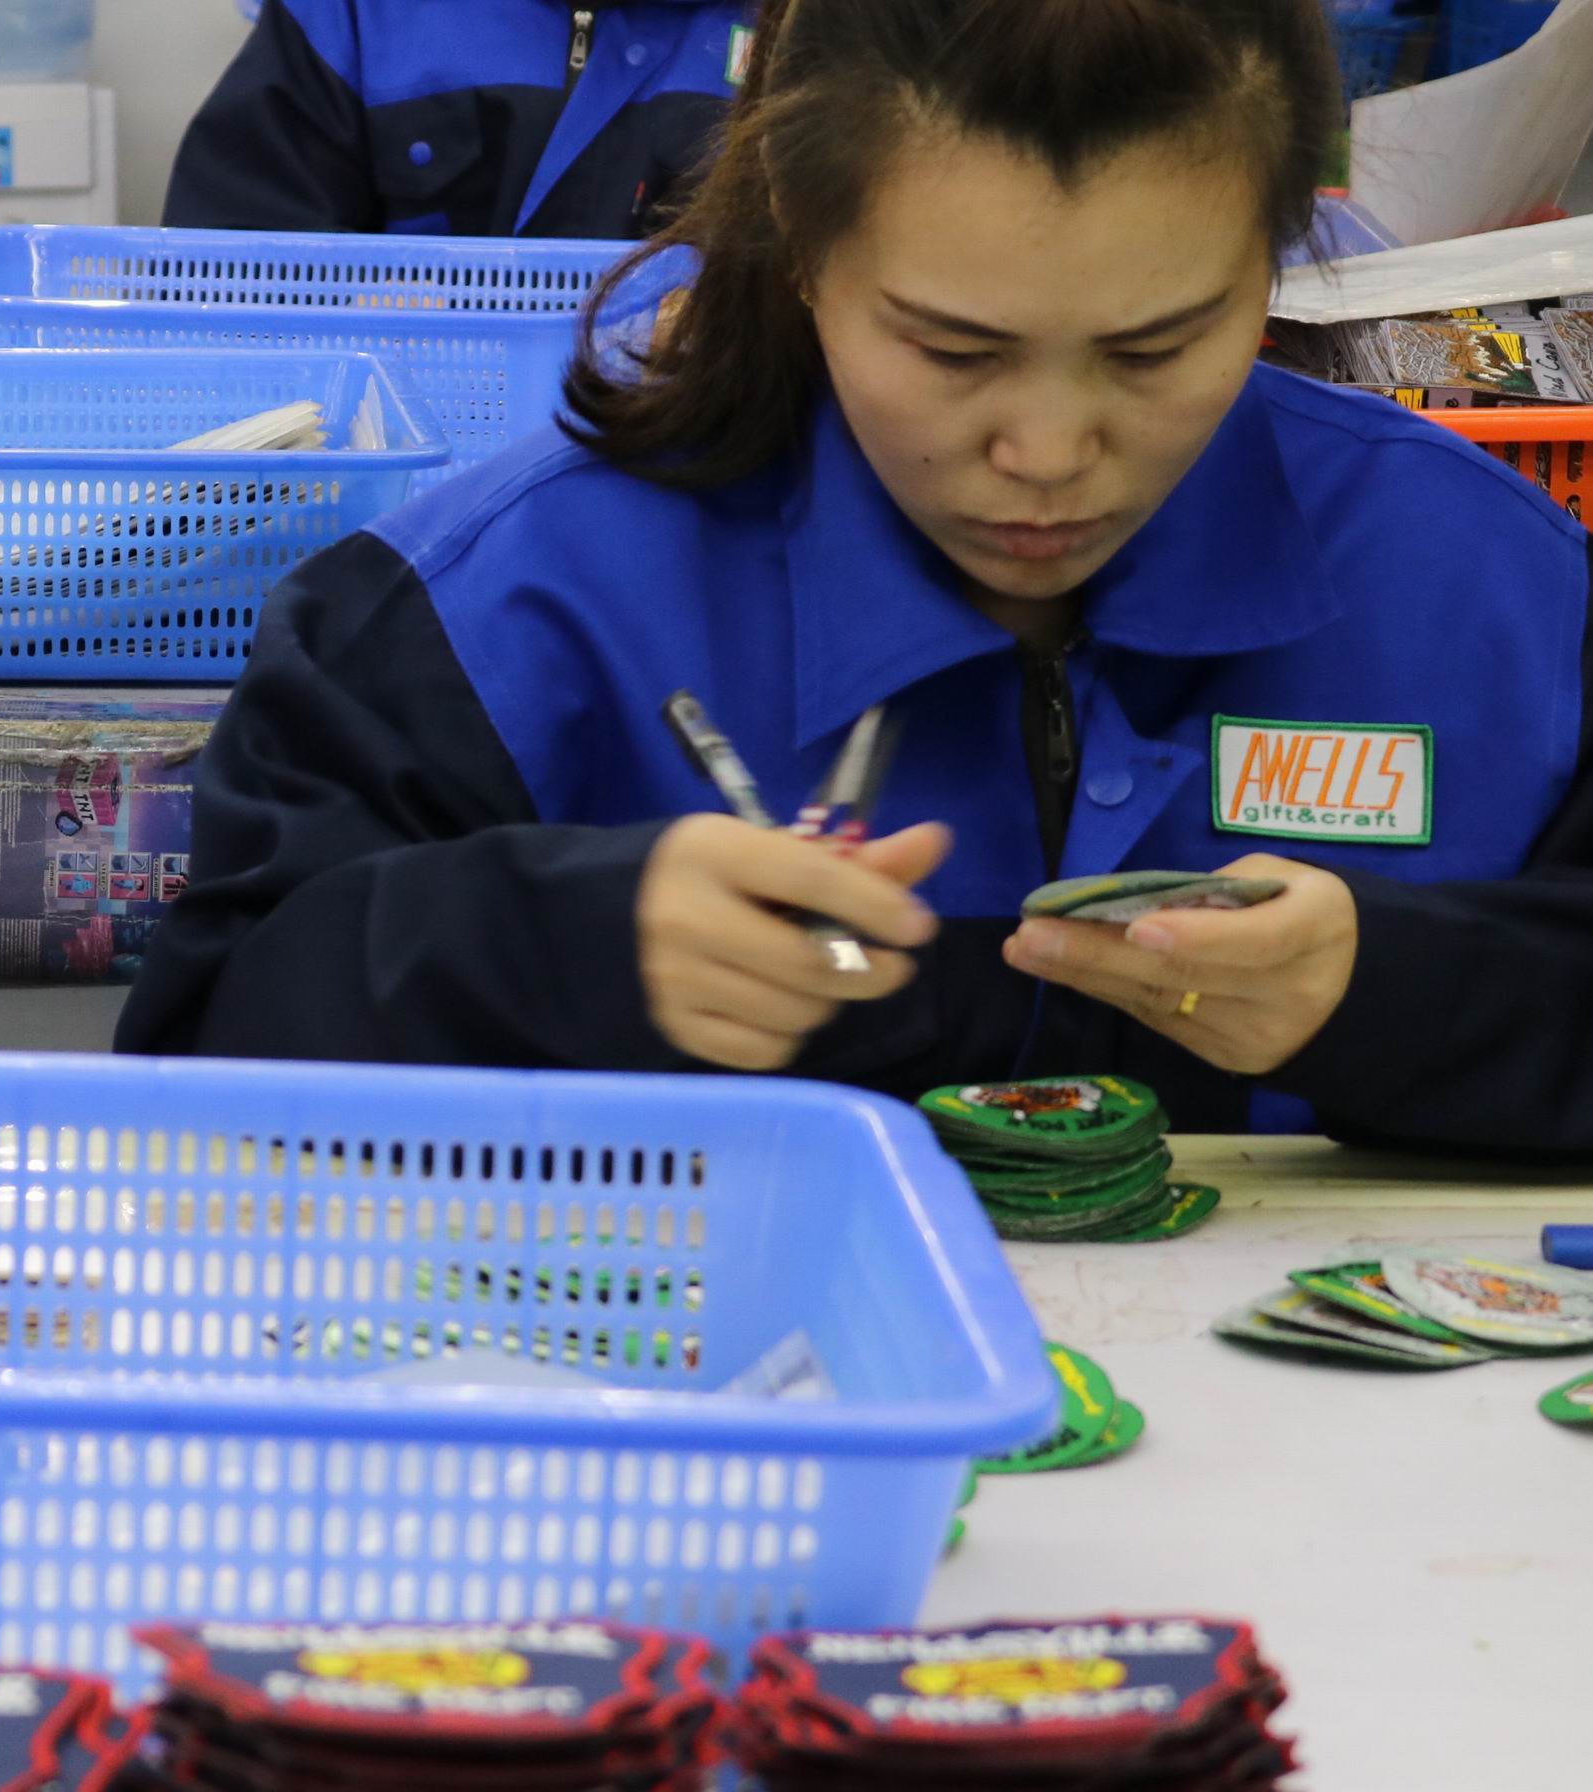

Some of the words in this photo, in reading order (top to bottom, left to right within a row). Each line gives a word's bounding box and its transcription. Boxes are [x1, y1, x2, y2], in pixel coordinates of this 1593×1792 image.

[1227, 731, 1417, 821] AWELLS
[74, 794, 94, 821] TNT
[1243, 804, 1398, 828] gift&craft
